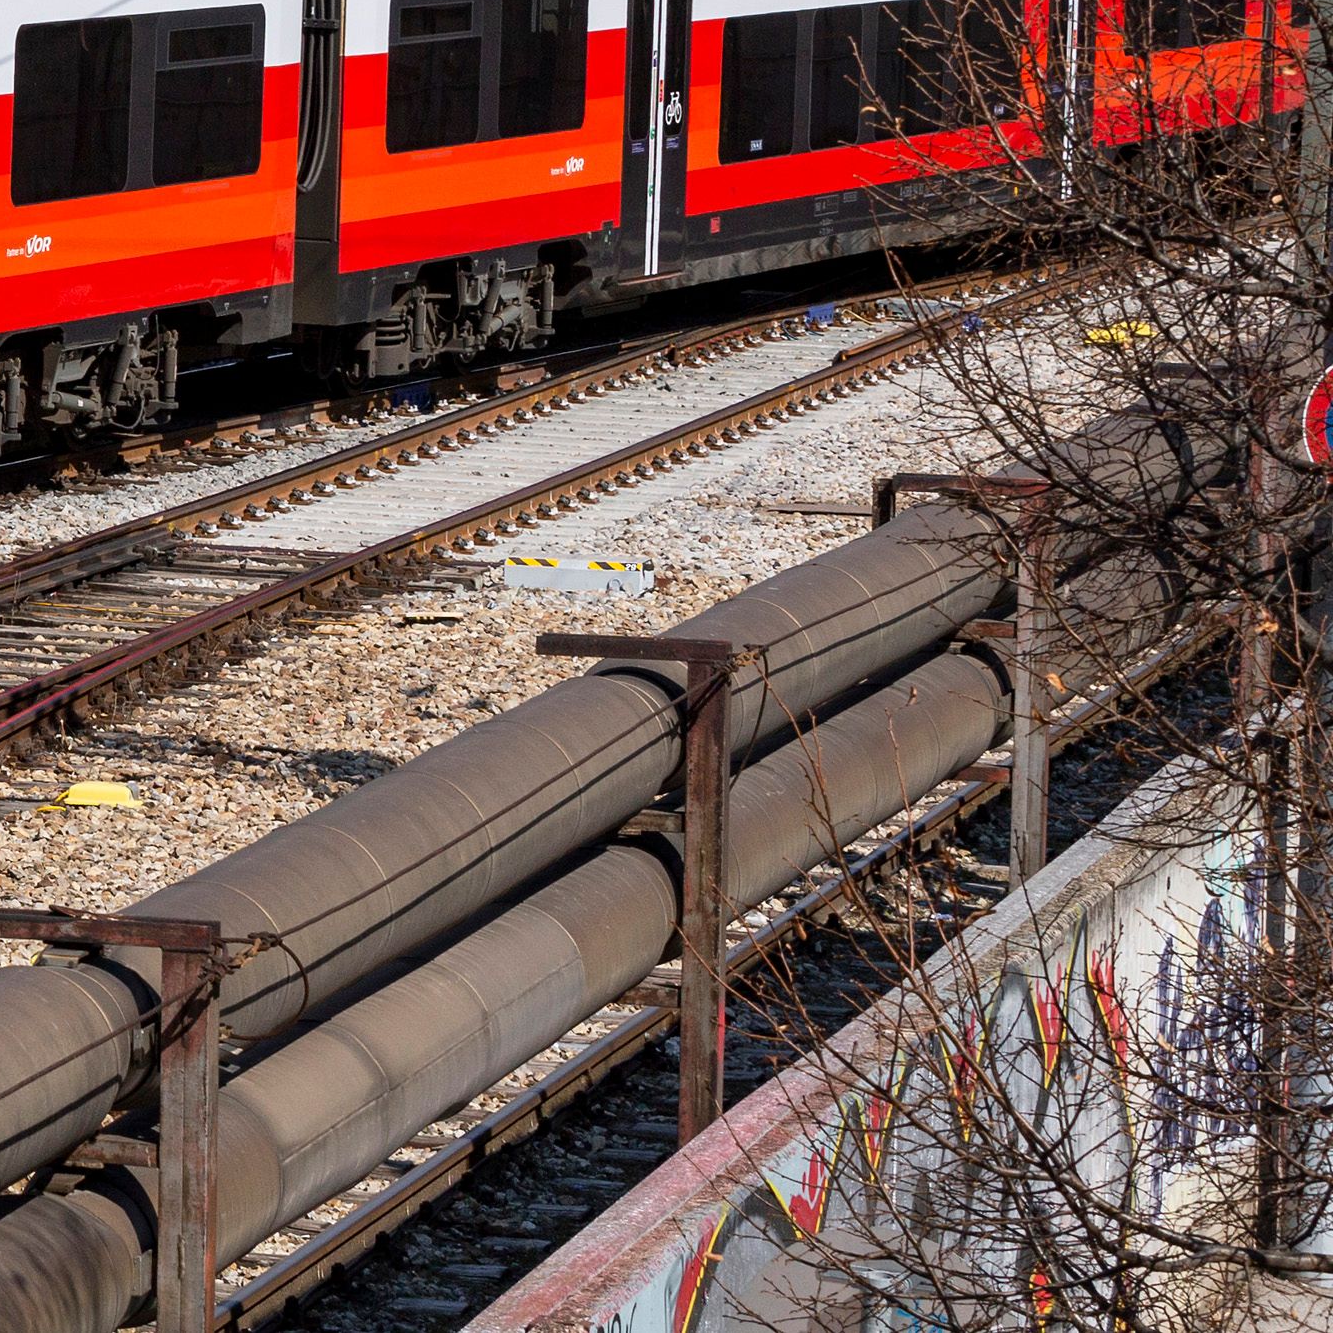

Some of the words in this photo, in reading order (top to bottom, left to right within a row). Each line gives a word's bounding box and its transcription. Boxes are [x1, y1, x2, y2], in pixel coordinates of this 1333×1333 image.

[565, 156, 585, 174] VOR
[25, 235, 52, 257] VOR
[625, 563, 636, 571] 29
